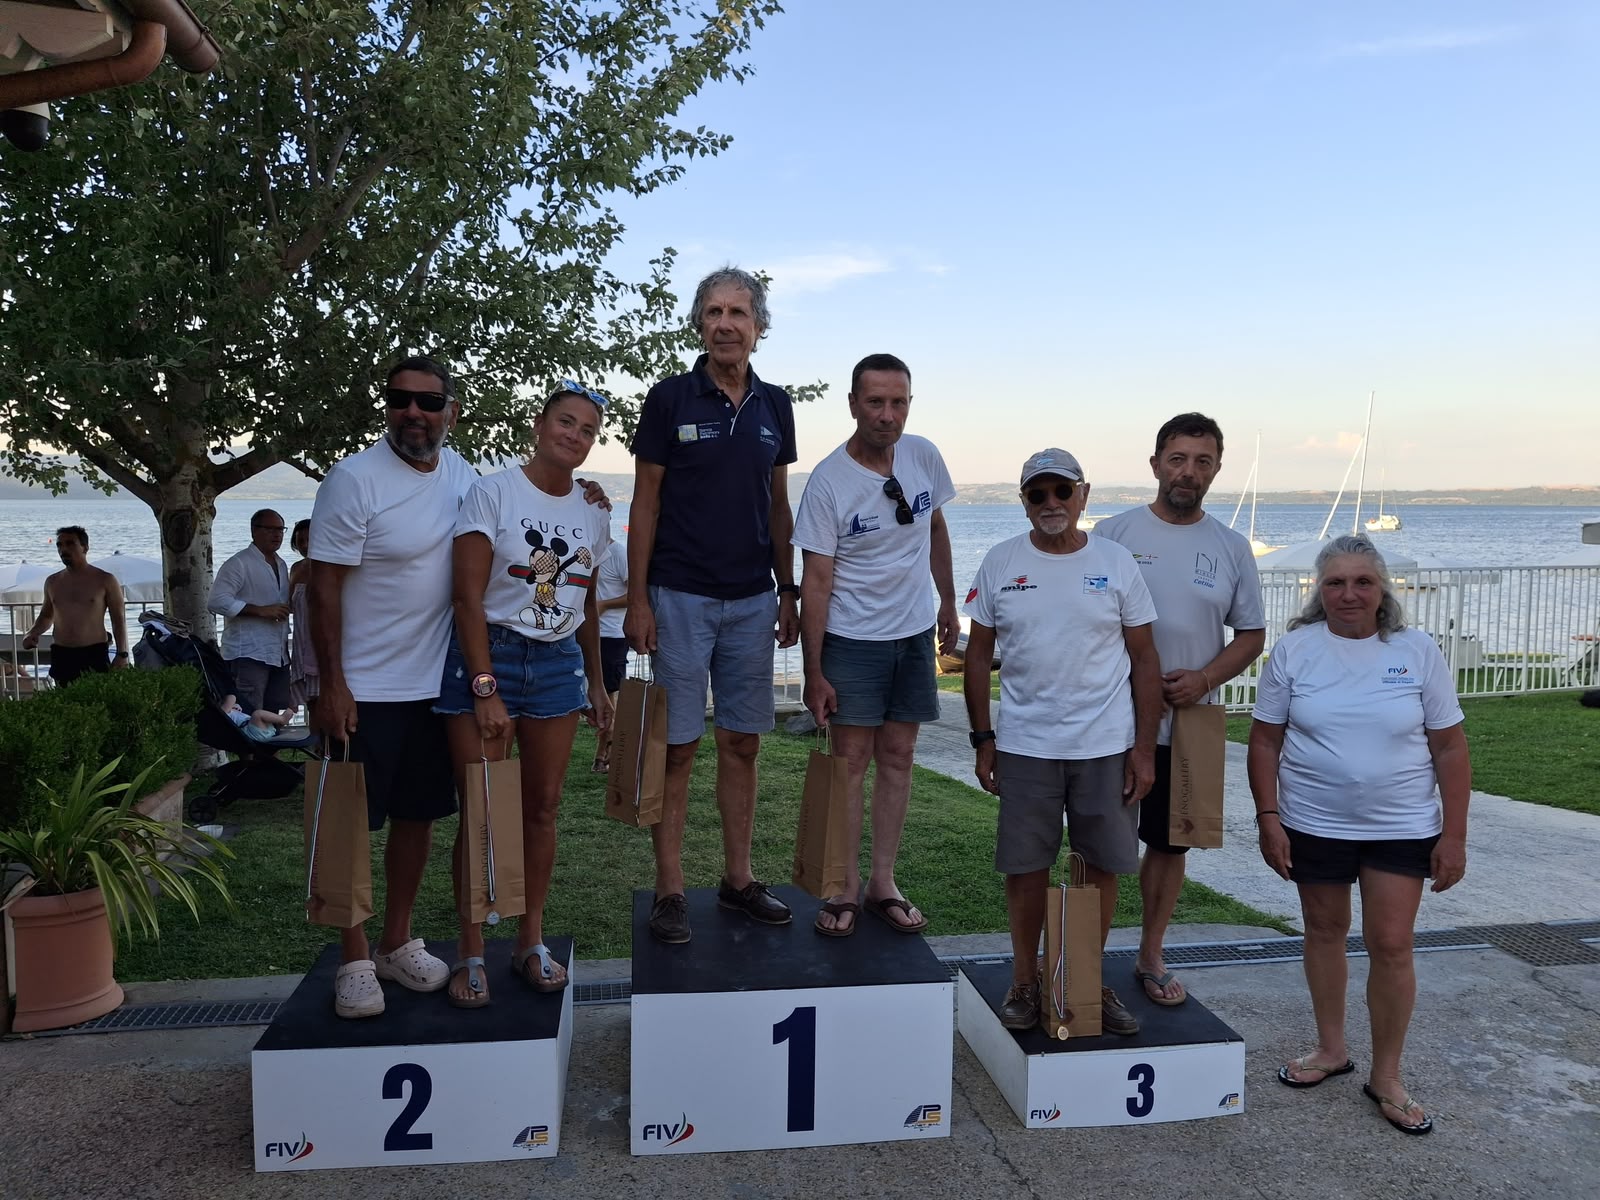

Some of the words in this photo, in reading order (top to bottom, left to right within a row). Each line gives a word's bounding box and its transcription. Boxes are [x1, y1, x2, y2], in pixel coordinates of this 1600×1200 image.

[521, 518, 583, 539] GUCC
[772, 1006, 816, 1132] 1
[1126, 1063, 1155, 1118] 3
[382, 1062, 433, 1152] 2
[1031, 1109, 1052, 1120] FIV
[643, 1123, 680, 1140] FIV
[265, 1142, 301, 1157] FIV
